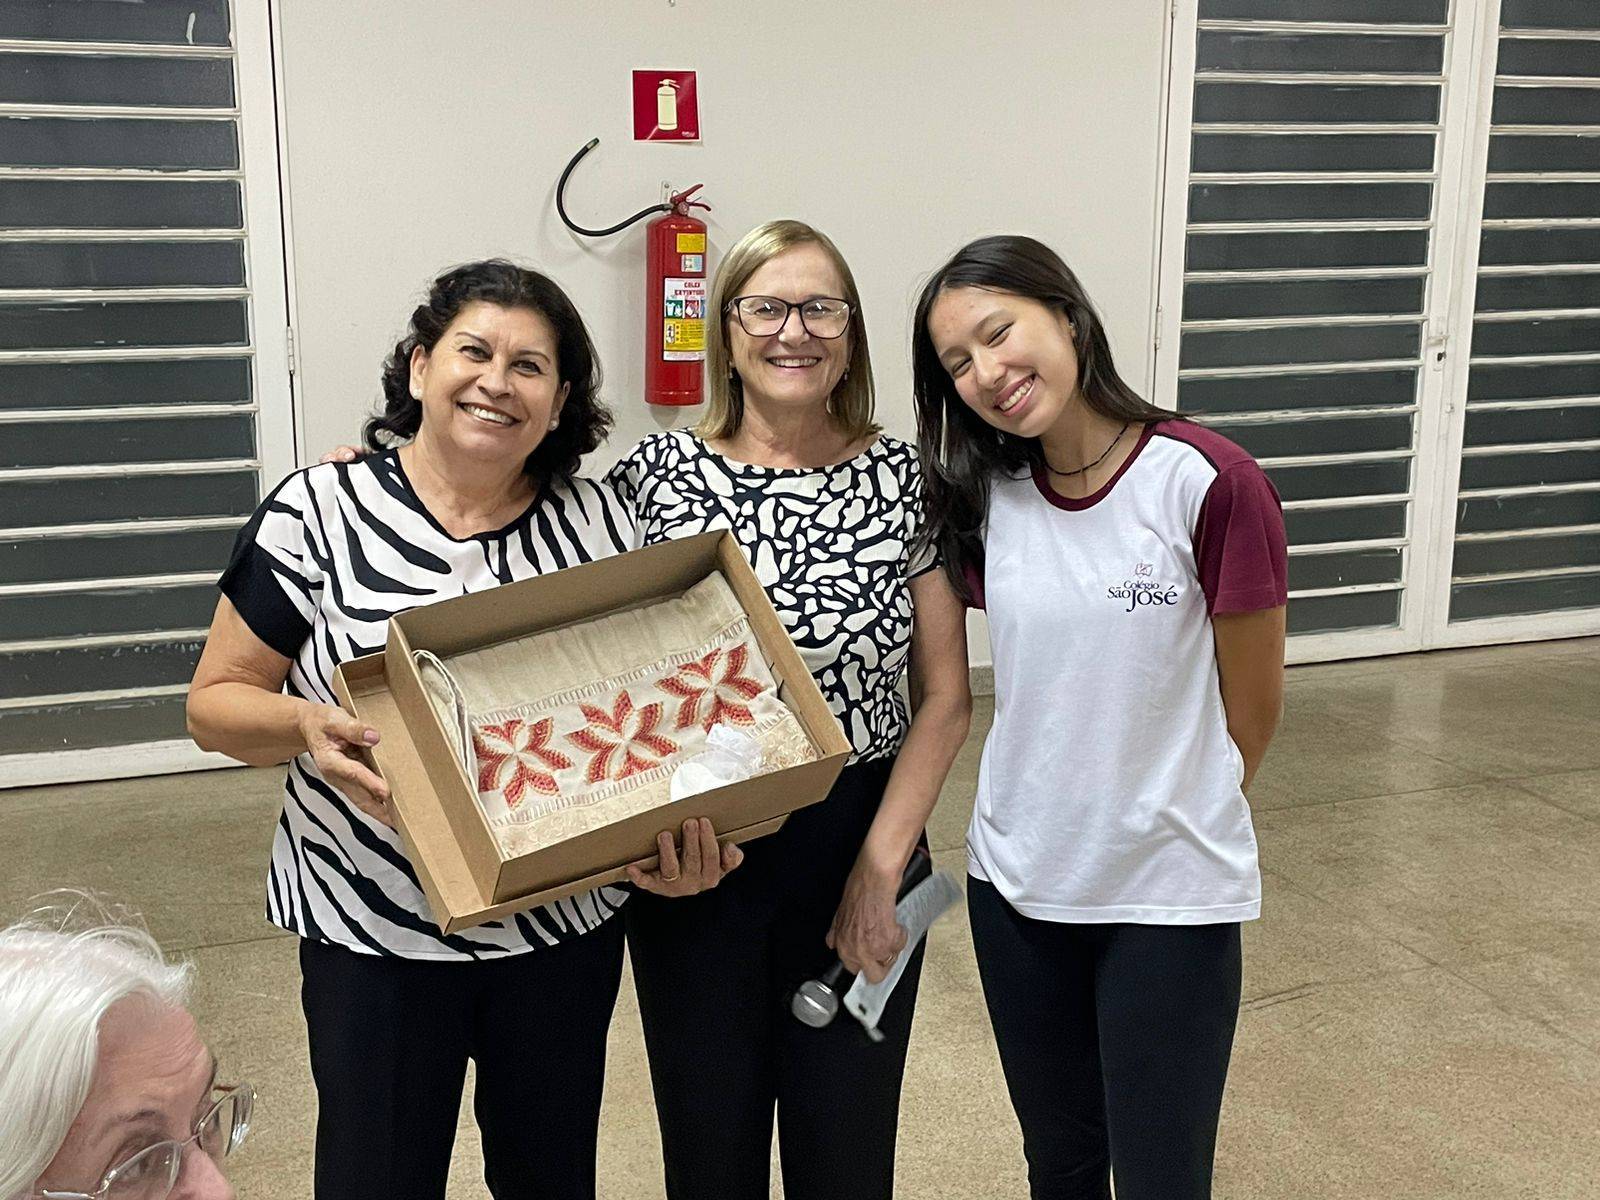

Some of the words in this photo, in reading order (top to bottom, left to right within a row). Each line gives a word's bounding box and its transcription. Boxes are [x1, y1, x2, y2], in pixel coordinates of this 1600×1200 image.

[1123, 580, 1160, 591] Colégio
[1106, 586, 1132, 599] São
[1126, 585, 1178, 612] José
